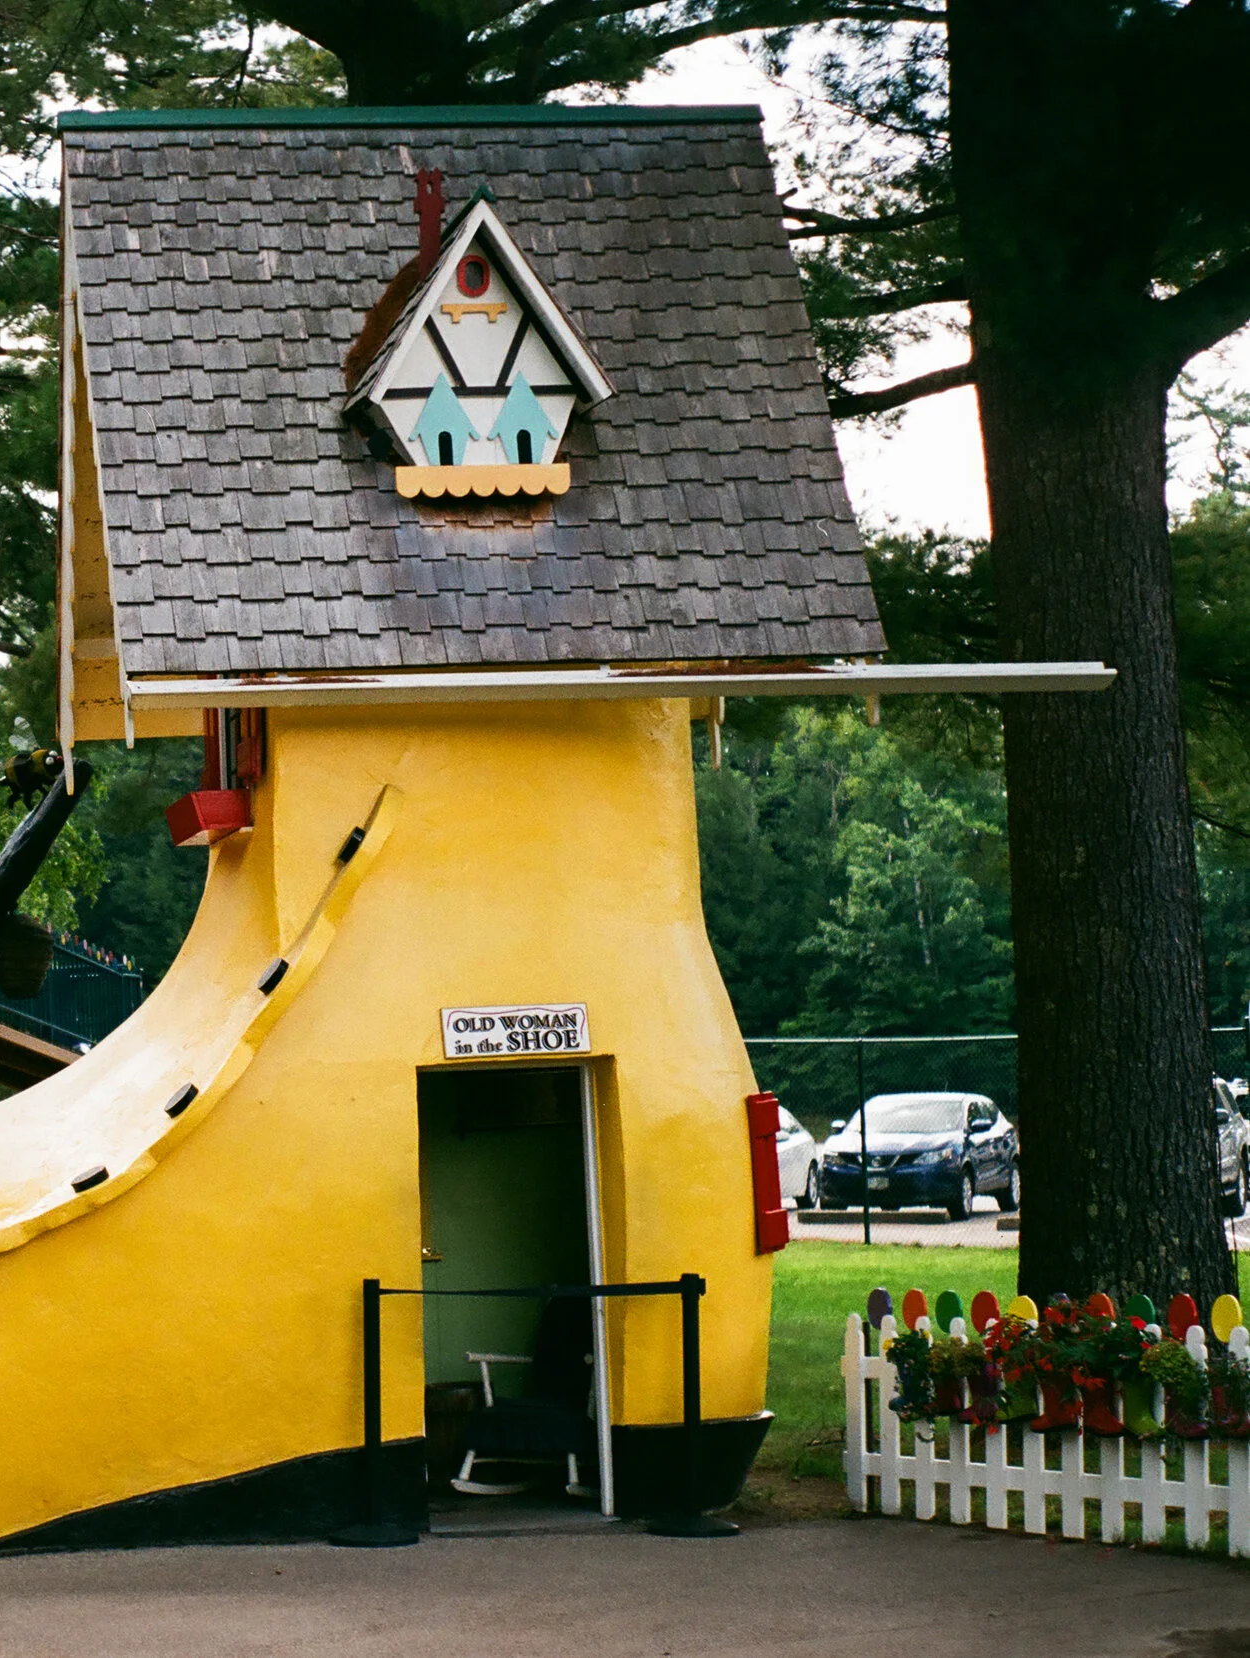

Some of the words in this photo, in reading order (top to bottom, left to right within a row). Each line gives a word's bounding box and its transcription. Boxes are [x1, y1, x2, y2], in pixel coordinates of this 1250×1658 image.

[453, 1017, 495, 1033] OLD
[499, 1013, 577, 1031] WOMAN
[455, 1040, 473, 1055] in
[477, 1038, 503, 1053] the
[507, 1029, 580, 1052] SHOE
